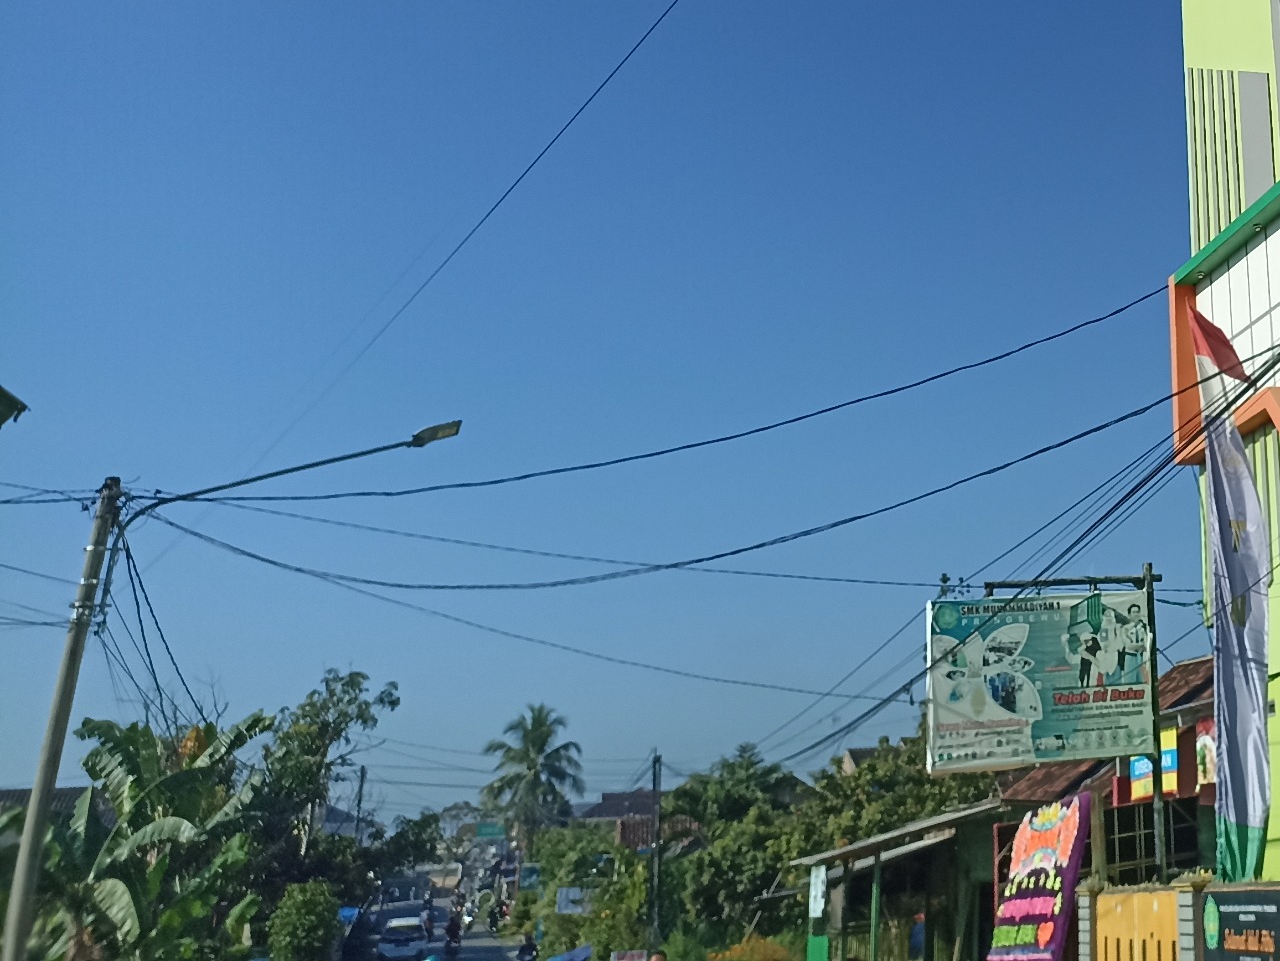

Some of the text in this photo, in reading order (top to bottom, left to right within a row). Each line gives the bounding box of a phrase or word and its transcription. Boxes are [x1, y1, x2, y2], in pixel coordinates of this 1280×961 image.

[961, 606, 980, 616] SMK
[1053, 691, 1090, 706] Telah
[1110, 688, 1145, 701] Buka
